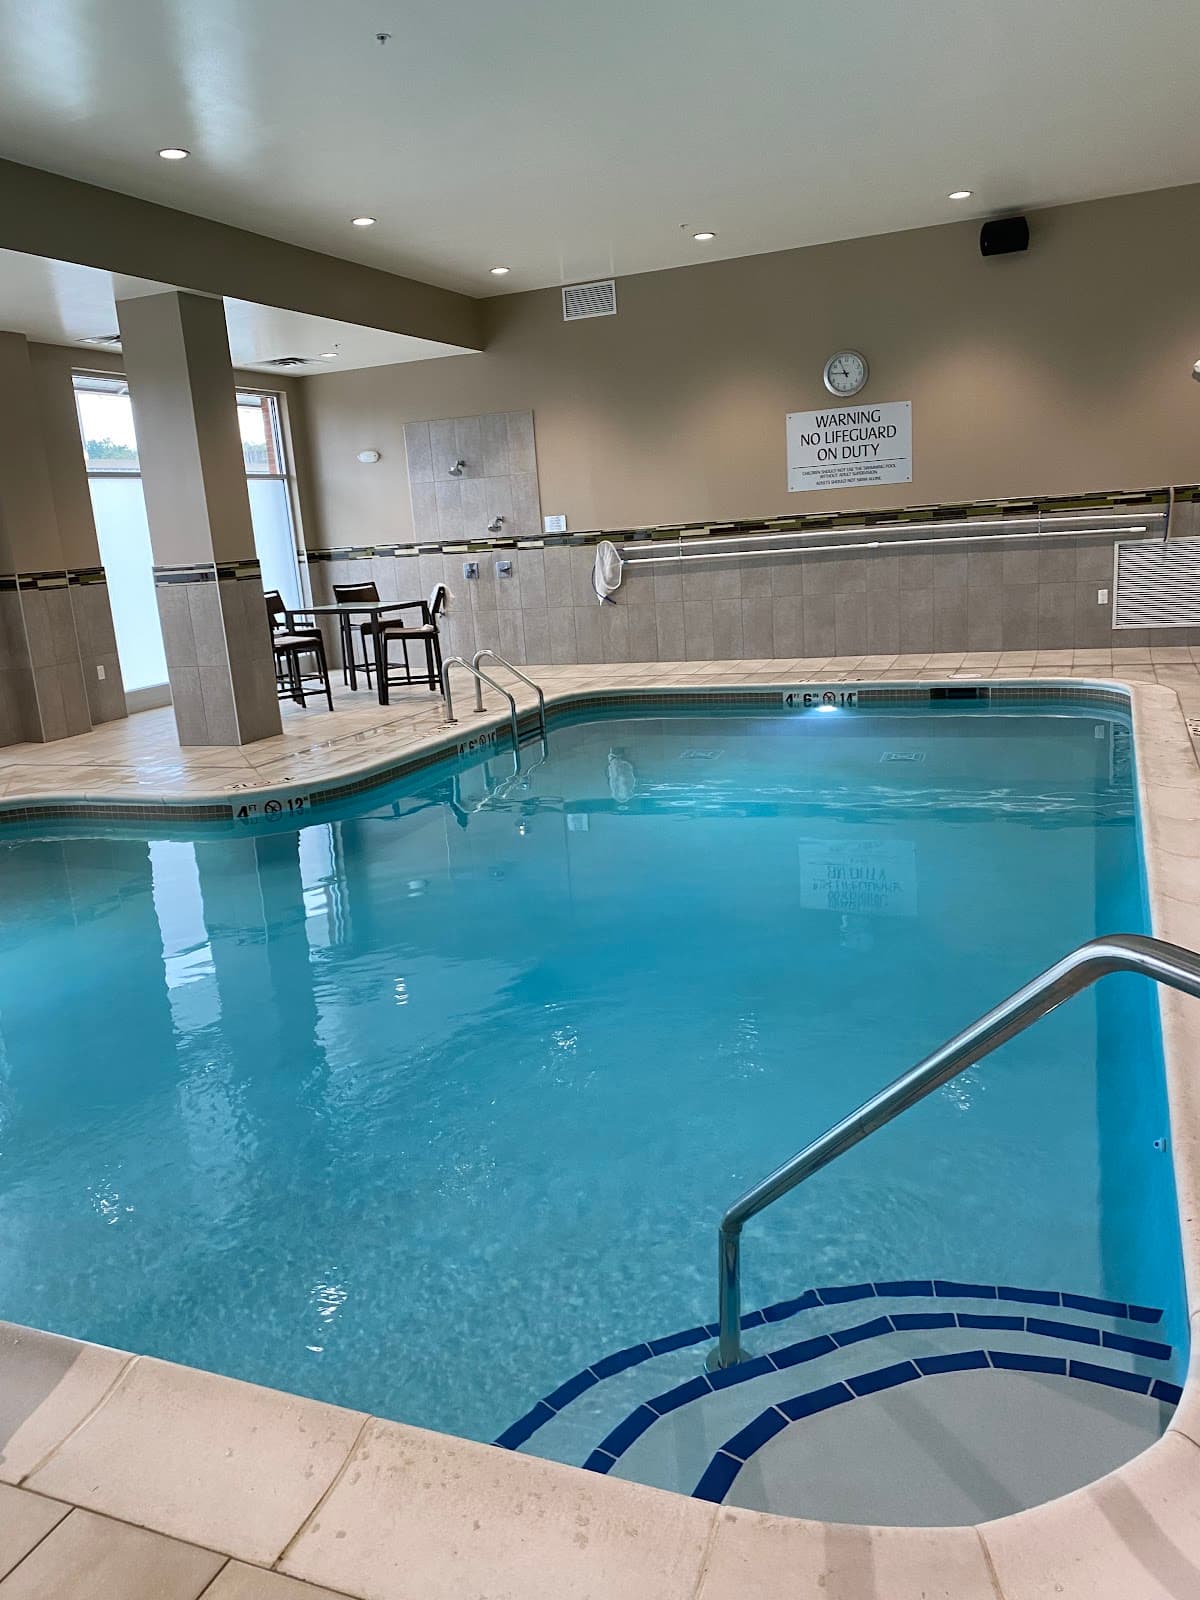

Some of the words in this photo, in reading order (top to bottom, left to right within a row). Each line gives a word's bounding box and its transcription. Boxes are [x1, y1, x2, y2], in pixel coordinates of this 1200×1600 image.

[815, 409, 881, 428] WARNING
[800, 432, 821, 447] NO
[825, 425, 897, 444] LIFEGUARD
[817, 447, 837, 461] ON
[842, 443, 880, 459] DUTY
